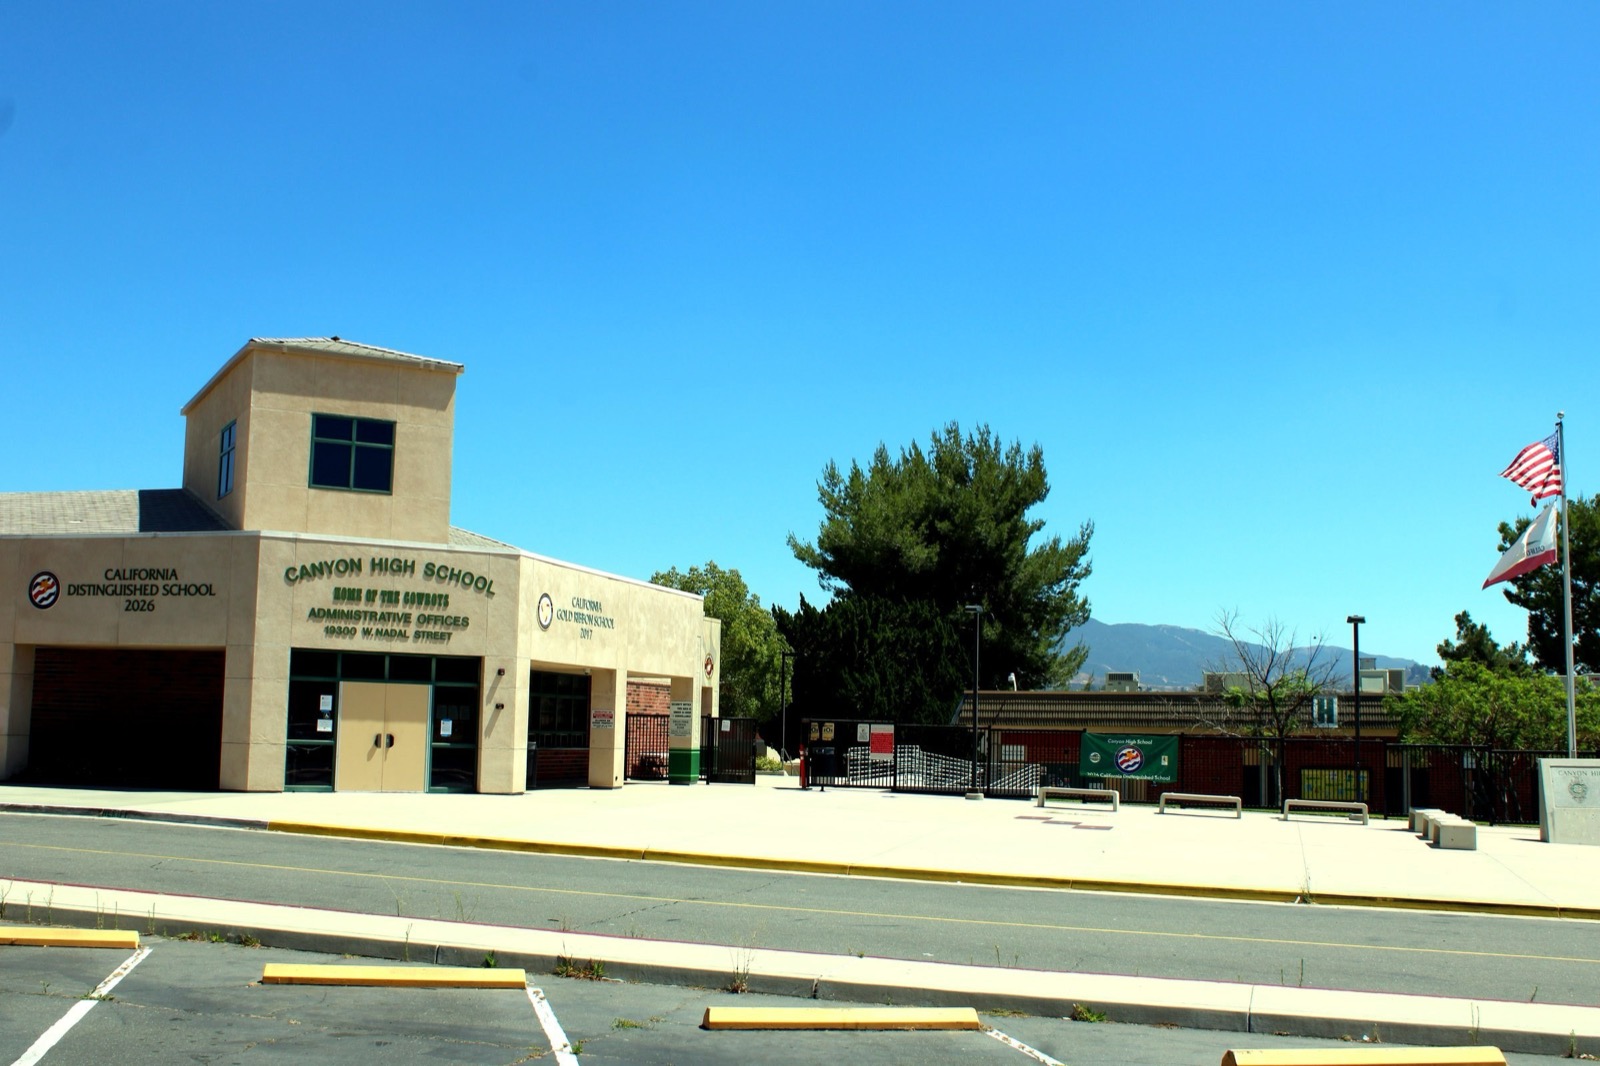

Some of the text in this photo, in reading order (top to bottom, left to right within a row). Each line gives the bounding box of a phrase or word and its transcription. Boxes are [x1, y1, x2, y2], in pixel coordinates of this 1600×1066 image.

[104, 568, 178, 581] CALIFORNIA
[284, 557, 496, 596] CANYON HIGH SCHOOL
[67, 583, 216, 596] DISTINGUISHED SCHOOL
[333, 586, 450, 607] HOME OF THE COWBOYS
[124, 599, 155, 612] 2026
[572, 597, 602, 613] CALIFORNIA
[308, 607, 470, 628] ADMINISTRATIVE OFFICES
[556, 608, 573, 622] GOLD
[594, 615, 614, 630] SCHOOL
[325, 625, 357, 636] 19300
[376, 628, 410, 638] NADAL
[413, 630, 453, 641] STREET
[580, 628, 593, 640] 2017
